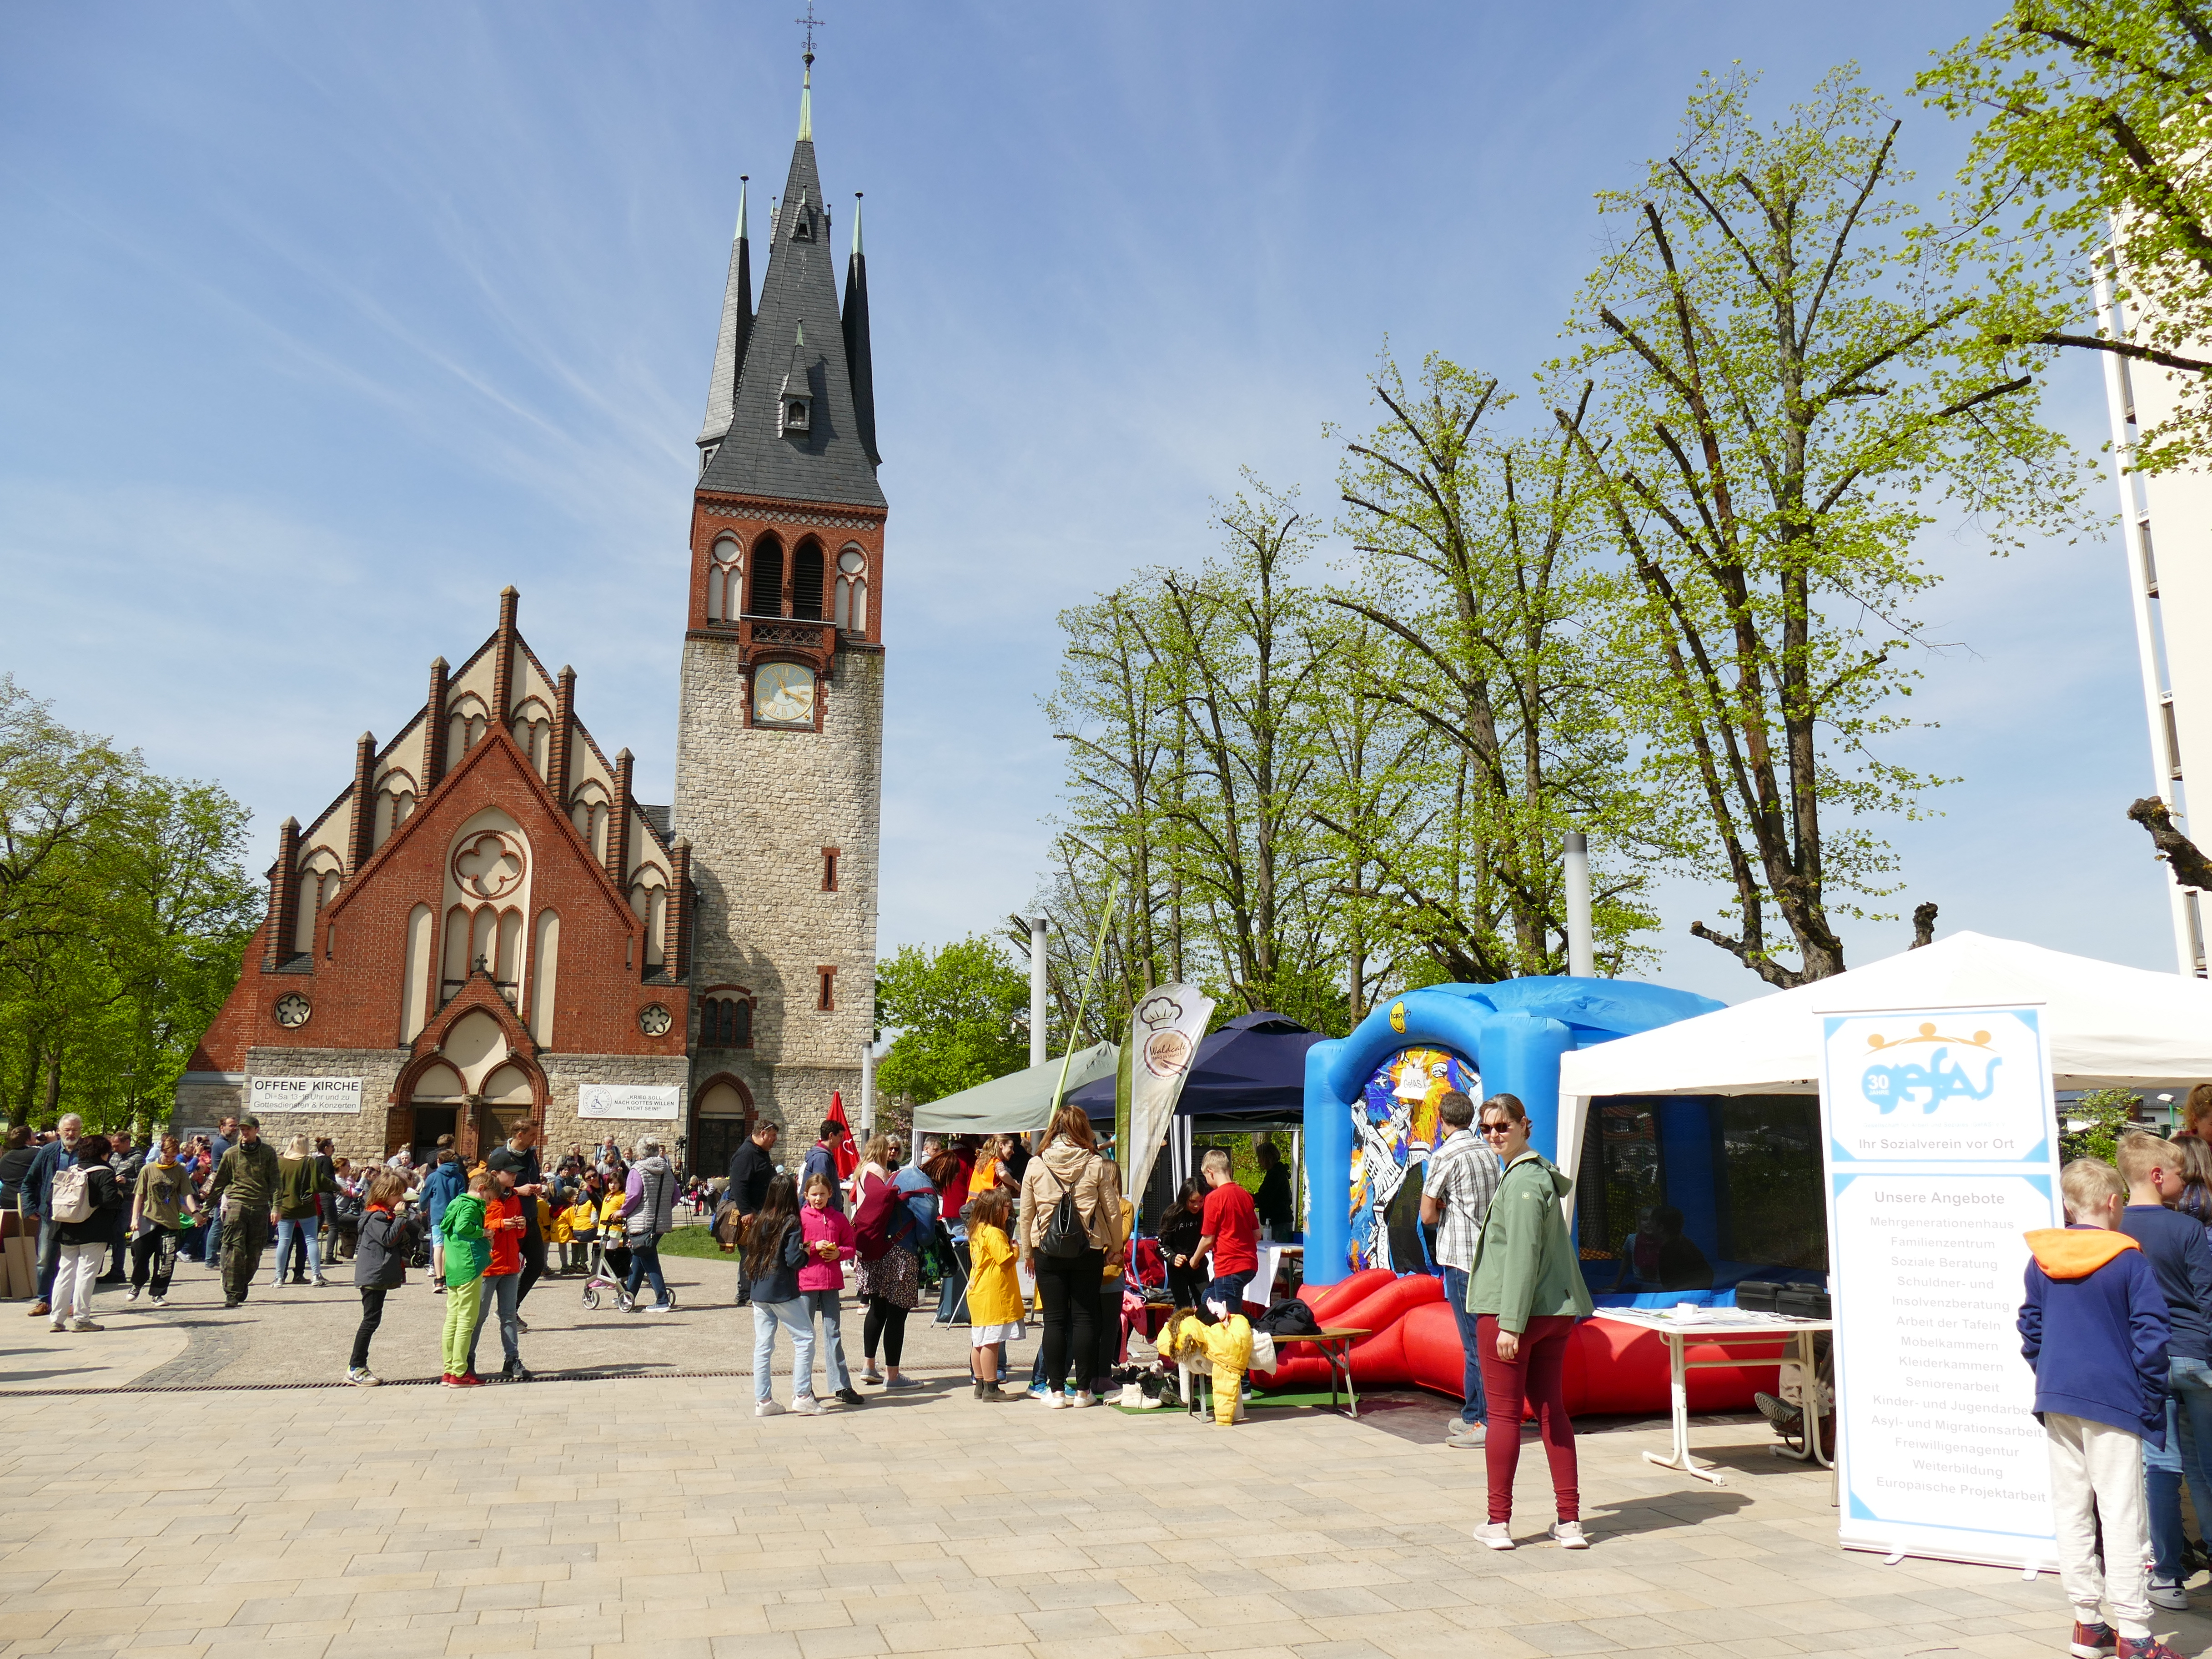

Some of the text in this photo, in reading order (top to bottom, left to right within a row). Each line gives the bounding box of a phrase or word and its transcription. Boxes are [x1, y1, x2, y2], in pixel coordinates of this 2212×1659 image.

[1150, 1042, 1187, 1055] Waldcafé
[255, 1081, 359, 1091] OFFENE KIRCHE
[1403, 1079, 1422, 1088] GefAS
[1868, 1074, 1889, 1090] 30
[1859, 1139, 1876, 1149] Ihr
[1881, 1139, 1961, 1149] Sozialverein
[1993, 1139, 2014, 1149] Ort
[1875, 1191, 2005, 1207] Unsere Angebote
[1870, 1217, 2014, 1229] Mehrgenerationenhaus
[1891, 1237, 1995, 1249] Familienzentrum
[1891, 1256, 1998, 1272] Soziale Beratung
[1897, 1277, 1994, 1289] Schuldner- und
[1892, 1296, 2010, 1312] Insolvenzberatung
[1896, 1317, 2001, 1330] Arbeit der Tafeln
[1901, 1336, 1998, 1351] Möbelkammern
[1899, 1356, 2004, 1372] Kleiderkammern
[1906, 1377, 2000, 1393] Seniorenarbeit
[1873, 1395, 2032, 1415] Kinder- und Jugendarbei
[1871, 1415, 2042, 1438] Asyl- und Migrationsarbeit
[1895, 1438, 2019, 1457] Freiwilligenagentur
[1913, 1459, 2003, 1479] Weiterbildung
[1877, 1477, 2046, 1502] Europäische Projektarbeit
